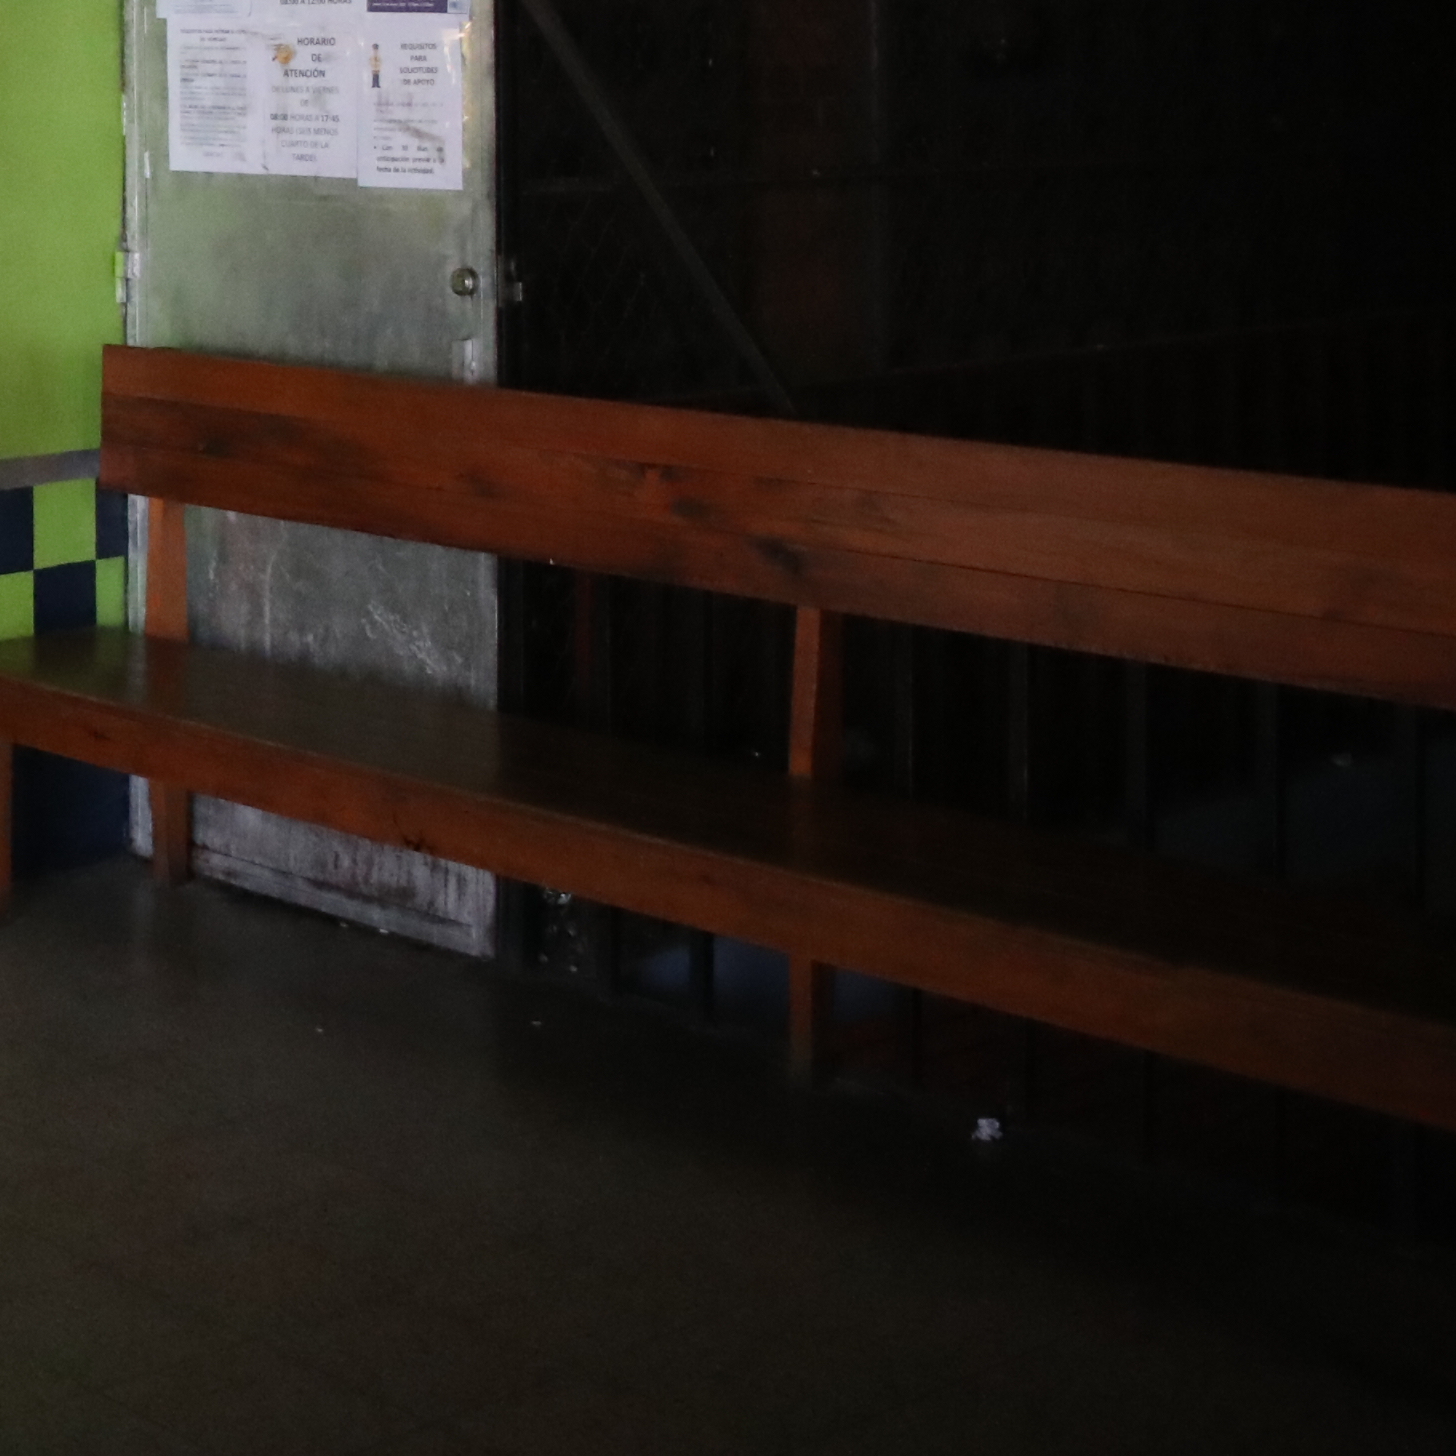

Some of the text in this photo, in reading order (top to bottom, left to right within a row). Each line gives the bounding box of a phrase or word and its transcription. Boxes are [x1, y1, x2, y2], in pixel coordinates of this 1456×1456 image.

[297, 37, 336, 46] HORARIO
[311, 54, 322, 62] DE
[283, 67, 326, 78] ATENCIÓN
